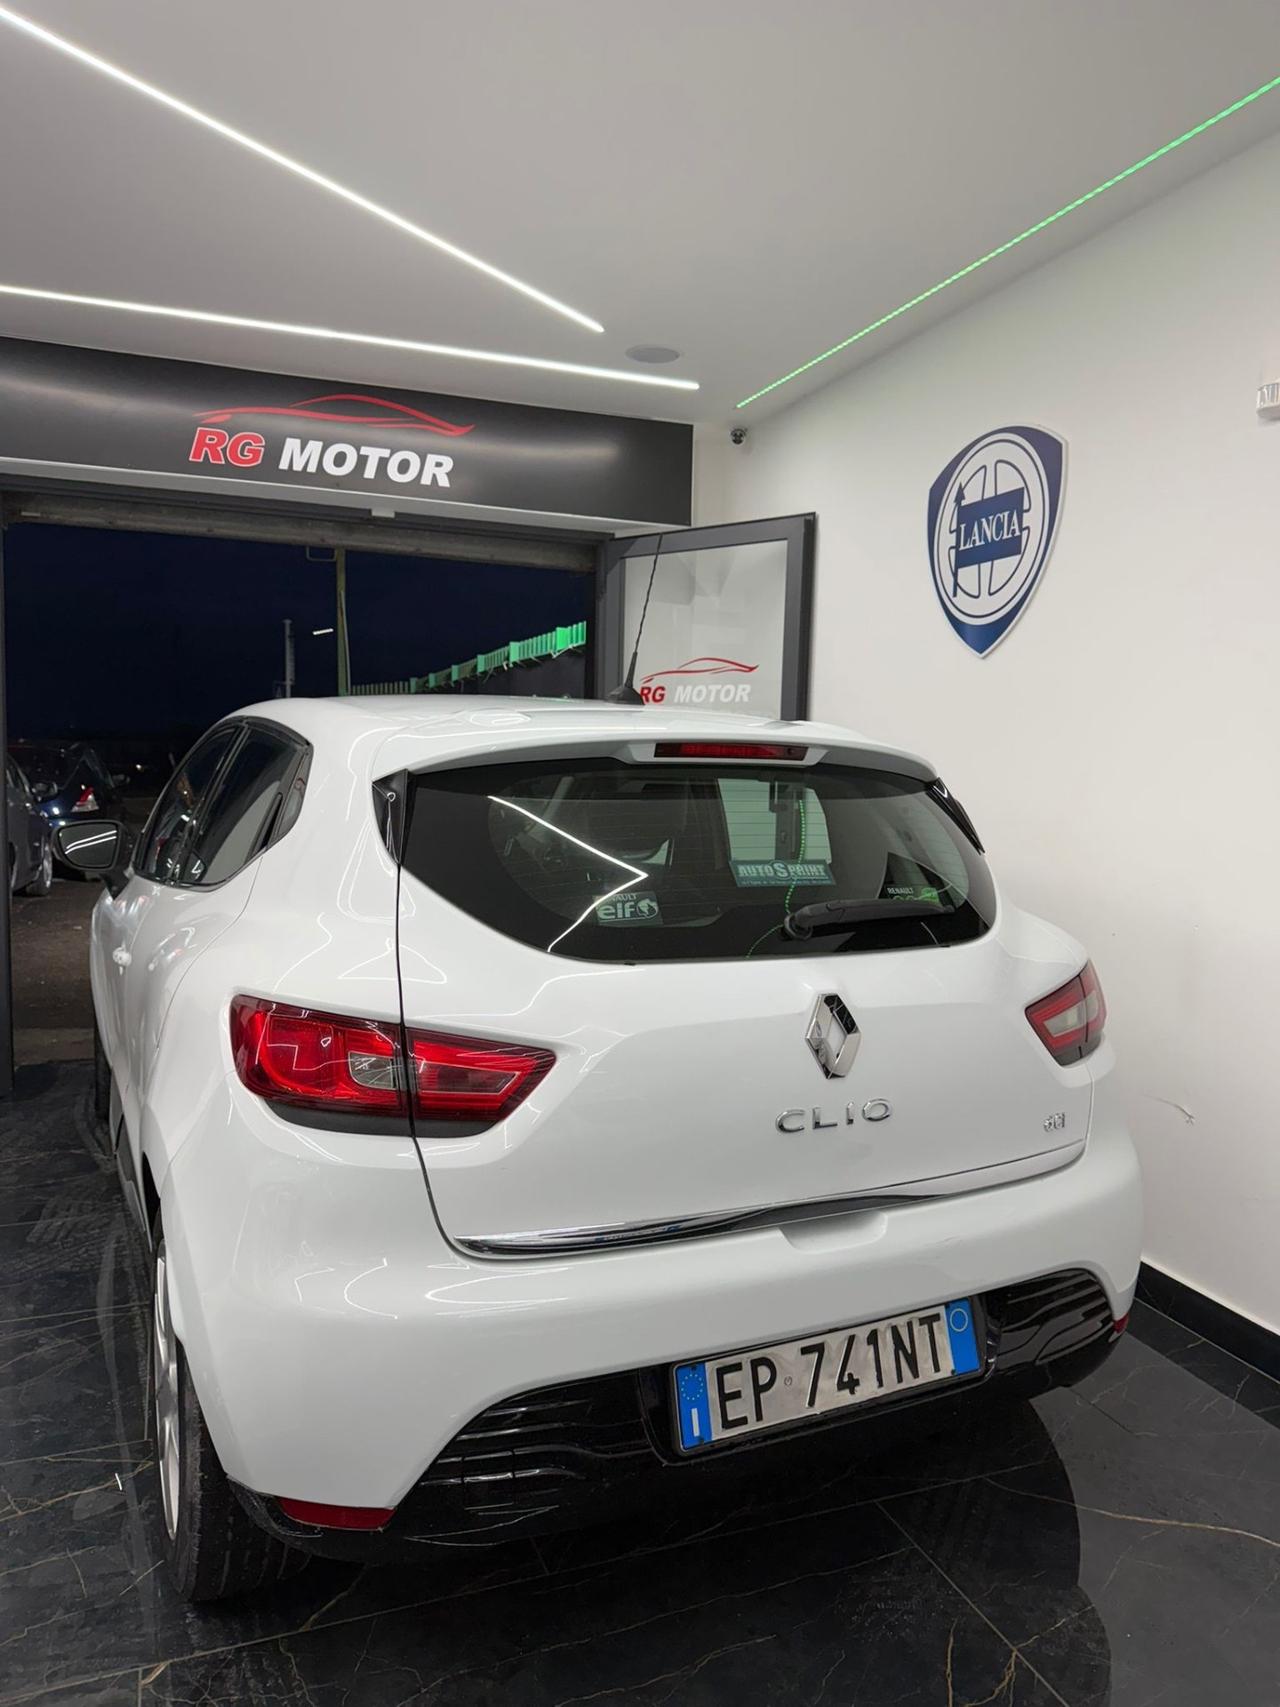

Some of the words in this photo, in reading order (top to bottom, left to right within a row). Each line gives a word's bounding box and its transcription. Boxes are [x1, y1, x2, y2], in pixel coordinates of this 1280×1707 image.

[189, 427, 266, 467] RG
[278, 437, 454, 488] MOTOR
[959, 509, 1021, 551] LANCIA
[639, 686, 666, 703] RG
[674, 684, 752, 703] MOTOR
[597, 902, 636, 919] elf
[775, 1098, 891, 1133] CLIO
[715, 1356, 778, 1430] EP
[800, 1313, 942, 1408] 741NT
